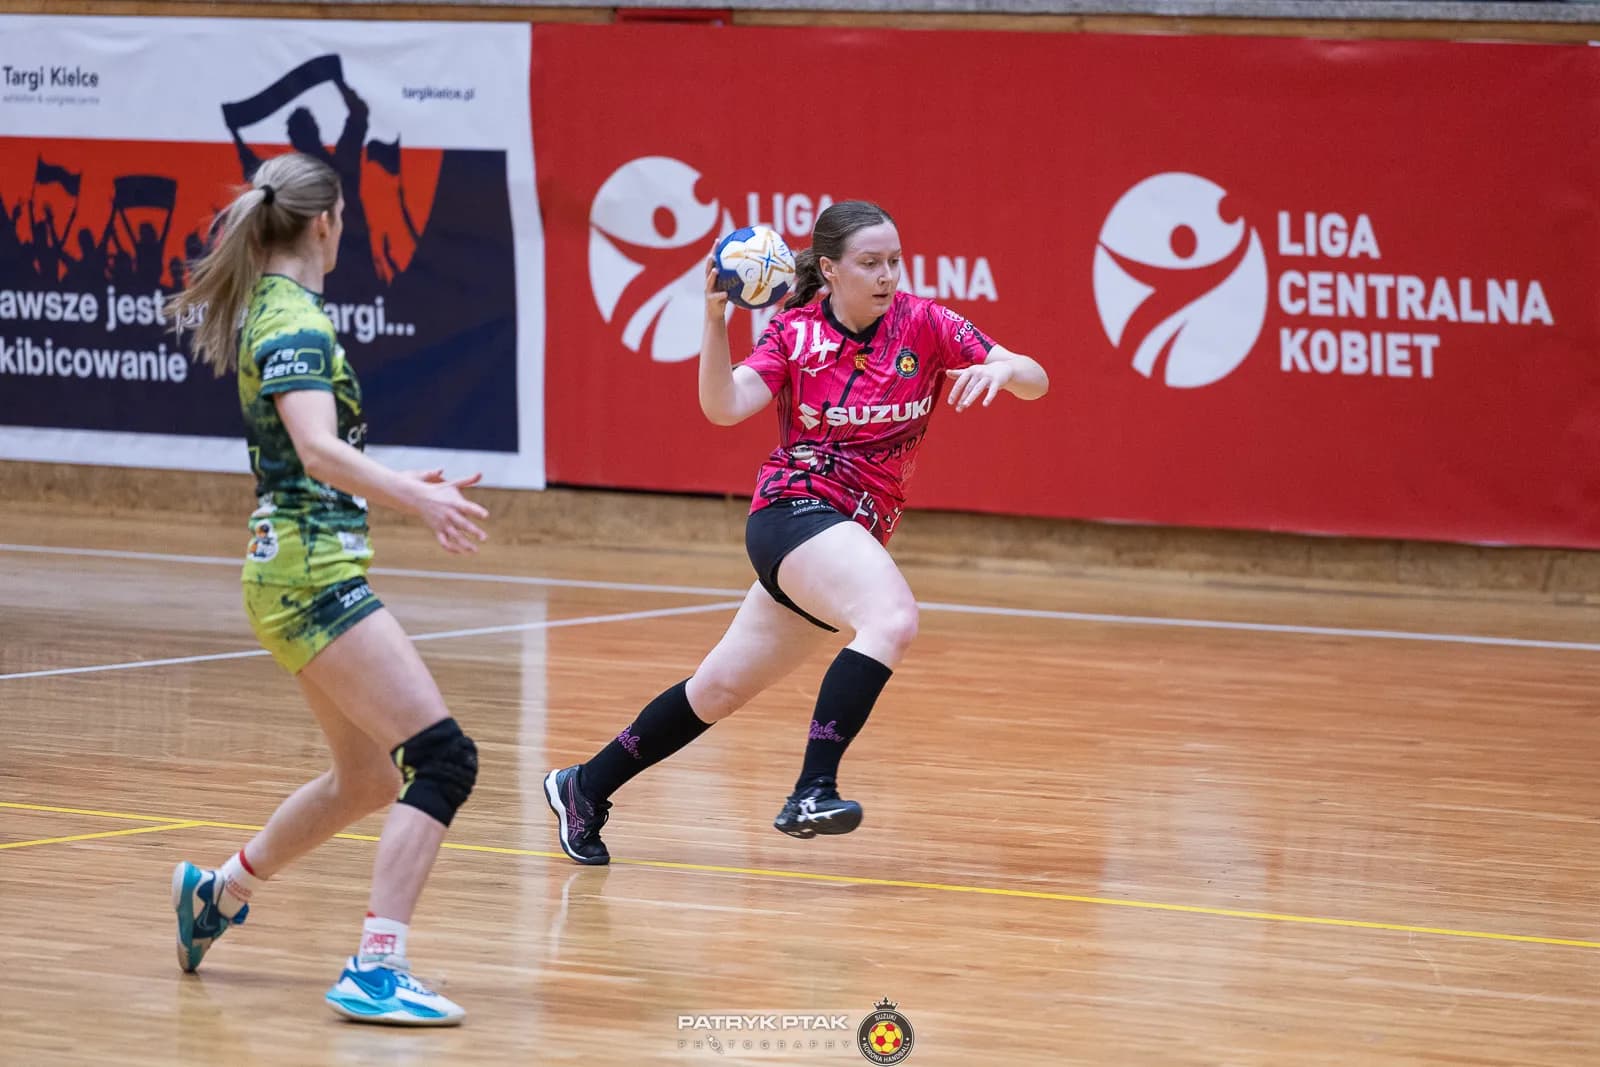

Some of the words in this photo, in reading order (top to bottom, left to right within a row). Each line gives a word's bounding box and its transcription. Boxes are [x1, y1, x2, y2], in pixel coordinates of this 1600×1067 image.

[3, 65, 44, 92] Targi
[50, 65, 99, 88] Kielce
[1278, 211, 1381, 259] LIGA
[0, 290, 98, 323] awsze
[106, 285, 167, 332] jest
[323, 296, 415, 344] argi...
[1278, 270, 1554, 326] CENTRALNA
[0, 337, 188, 383] kibicowanie
[1280, 328, 1440, 379] KOBIET
[825, 395, 932, 427] SUZUKI
